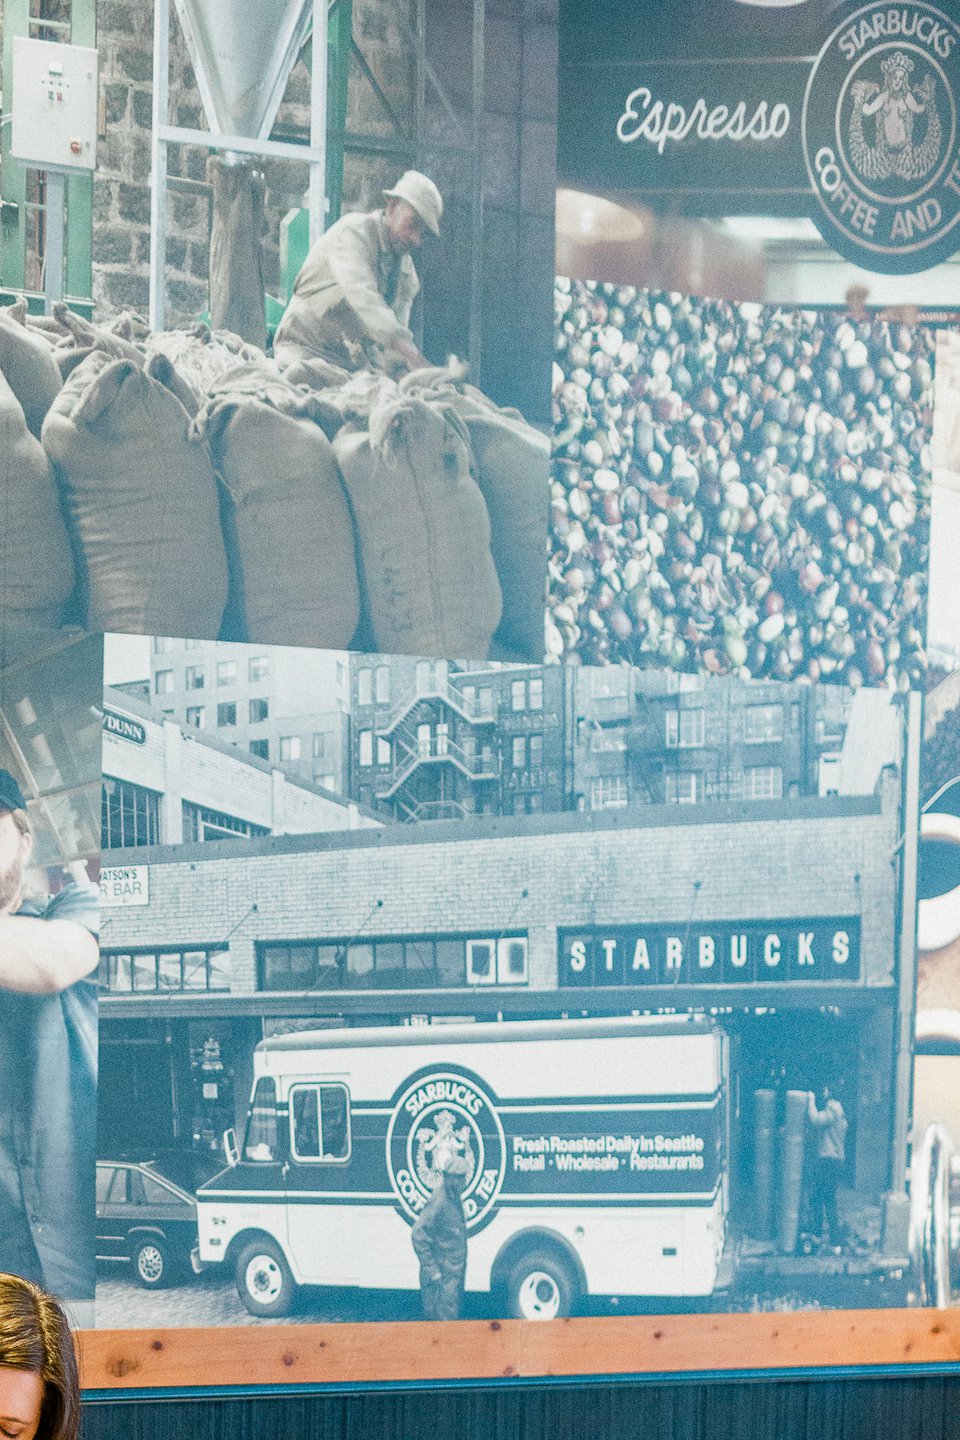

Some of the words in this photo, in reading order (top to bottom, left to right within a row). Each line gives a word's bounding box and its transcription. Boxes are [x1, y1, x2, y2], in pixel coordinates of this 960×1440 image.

[838, 9, 957, 61] STARBUCKS
[616, 87, 791, 155] Espresso
[814, 146, 880, 237] COFFEE
[889, 198, 942, 241] AND
[113, 881, 142, 896] BAR
[569, 930, 850, 973] STARBUCKS
[404, 1081, 484, 1118] STARBUCKS
[512, 1136, 549, 1153] Fresh
[549, 1135, 606, 1153] Roasted
[606, 1134, 639, 1156] Daily
[654, 1134, 705, 1152] Seattle
[513, 1154, 546, 1172] Retail
[555, 1153, 620, 1171] Wholesale
[629, 1152, 705, 1171] Restaurants
[474, 1168, 499, 1202] TEA
